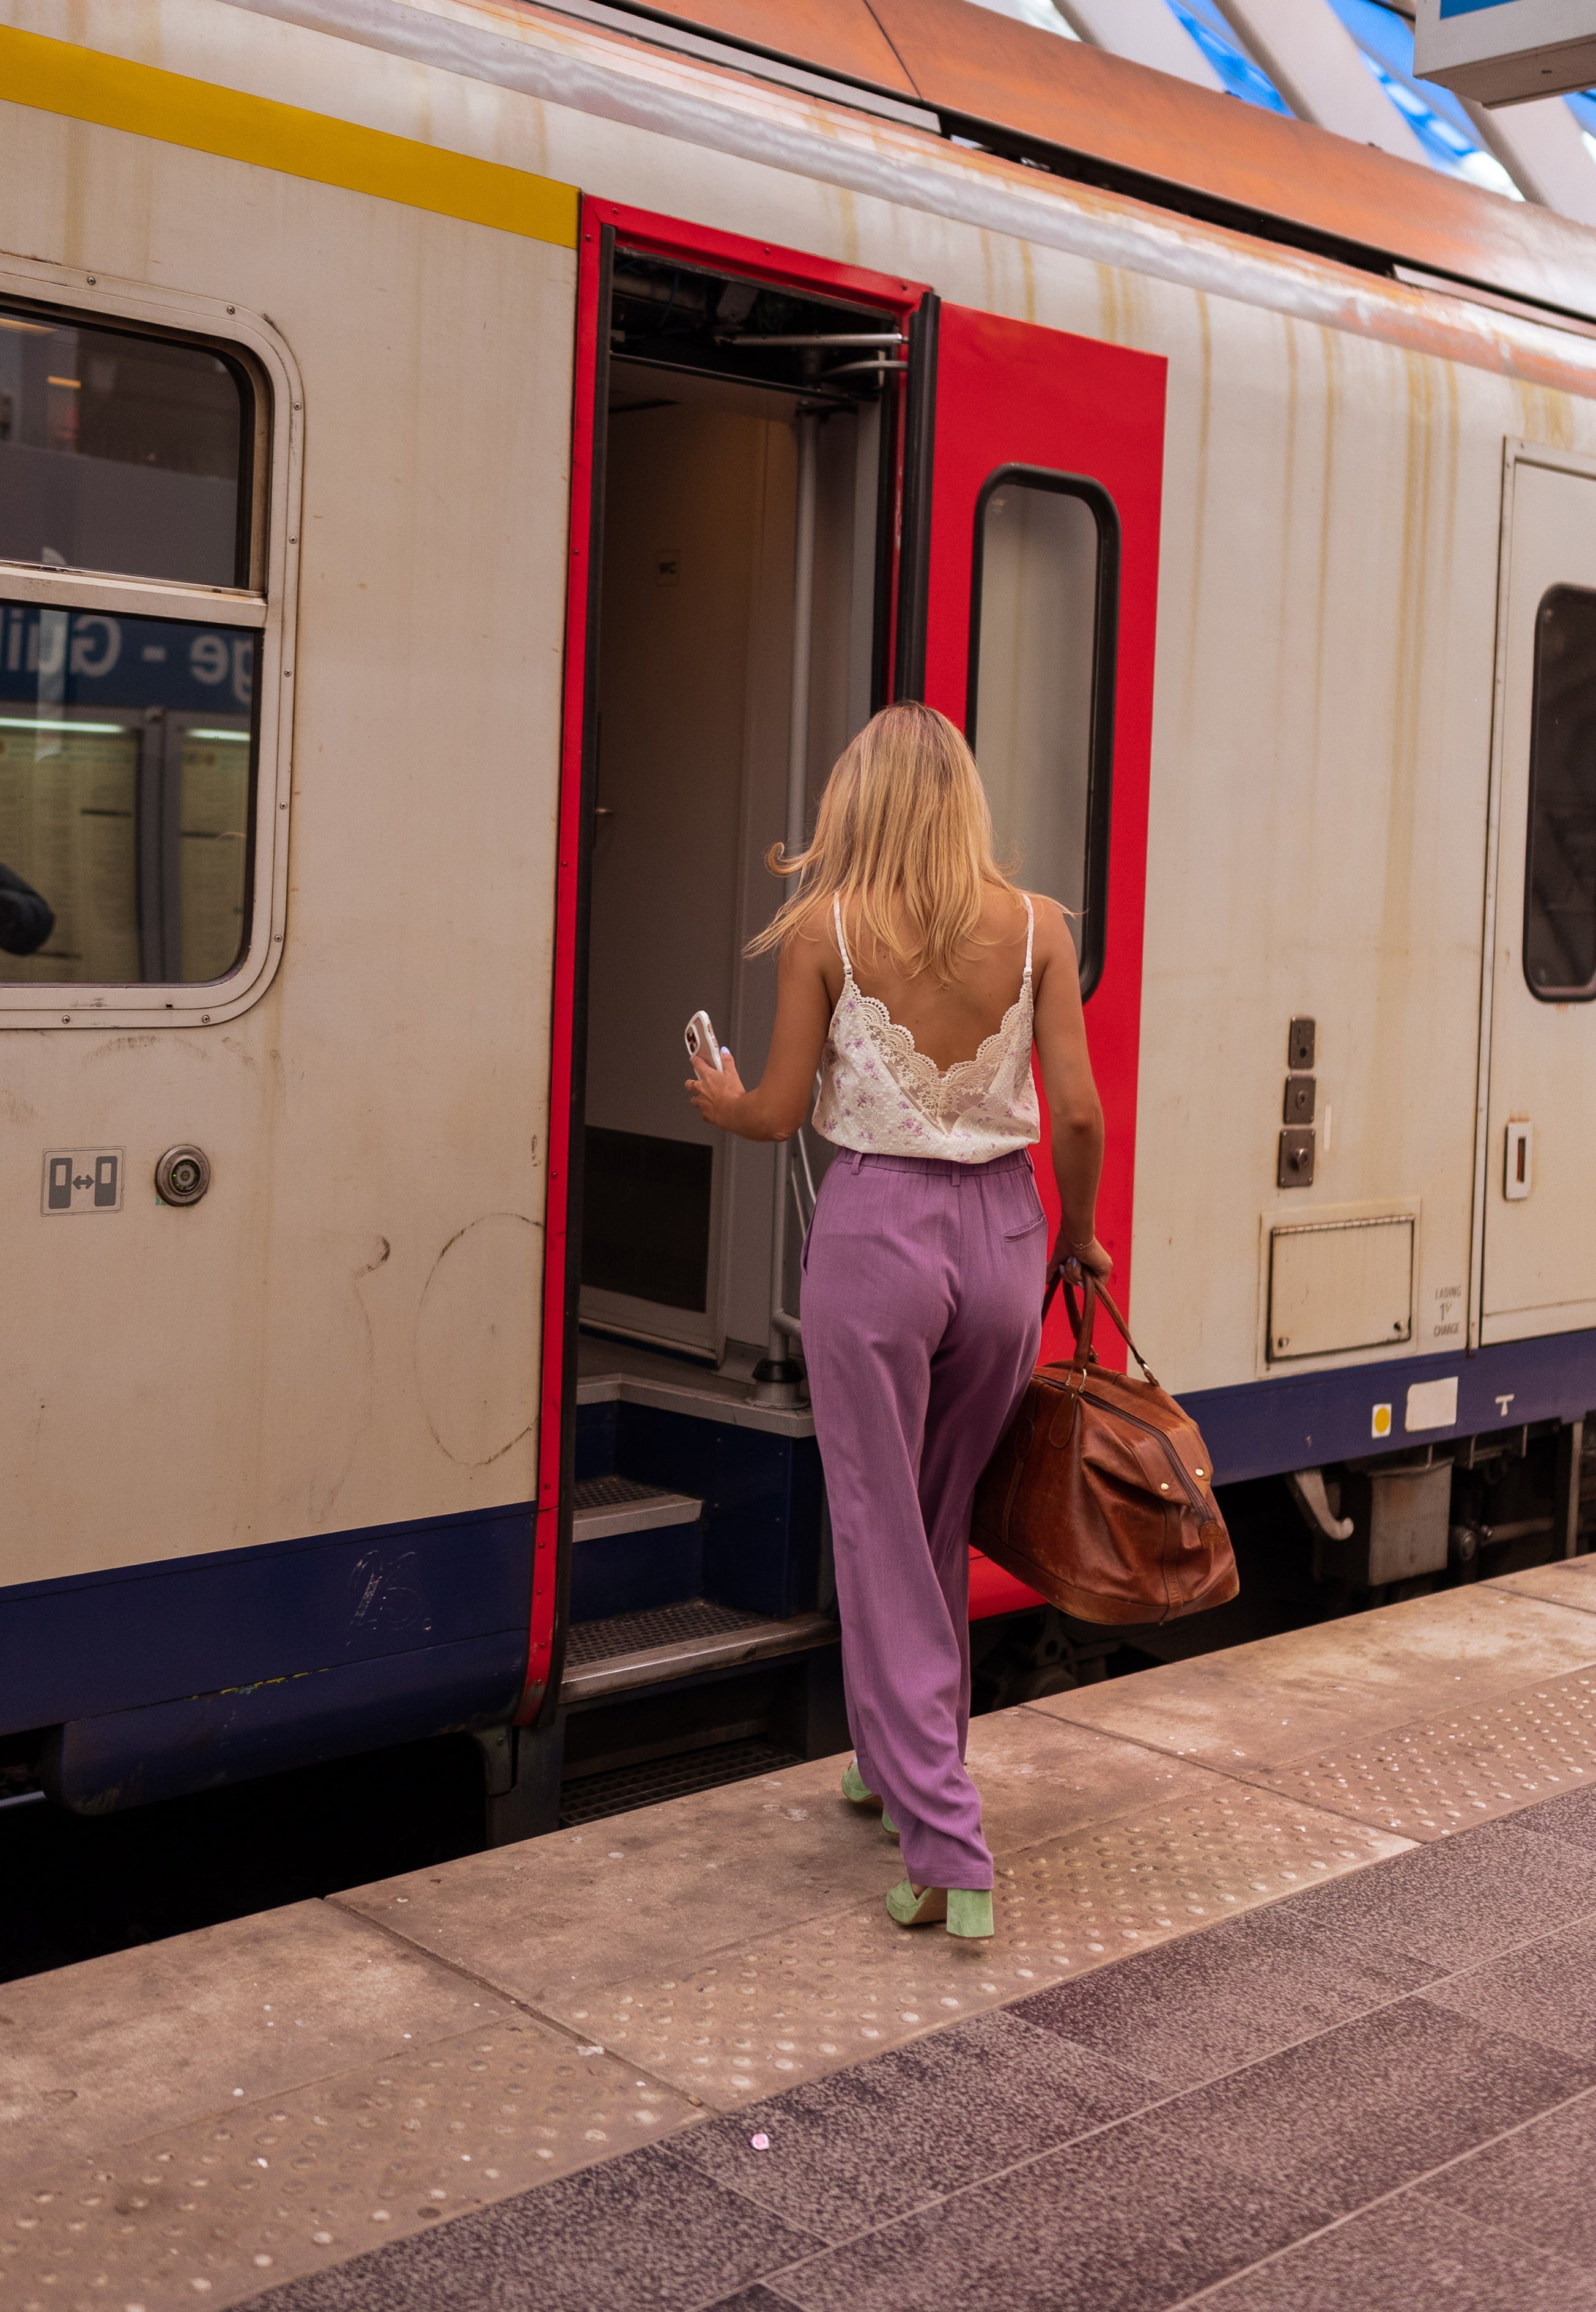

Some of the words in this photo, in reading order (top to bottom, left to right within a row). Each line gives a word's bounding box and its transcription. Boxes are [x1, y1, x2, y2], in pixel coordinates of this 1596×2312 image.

[659, 561, 677, 575] WC
[1435, 1285, 1461, 1300] LADING
[1433, 1321, 1460, 1338] CHARGE
[1495, 1393, 1515, 1417] T
